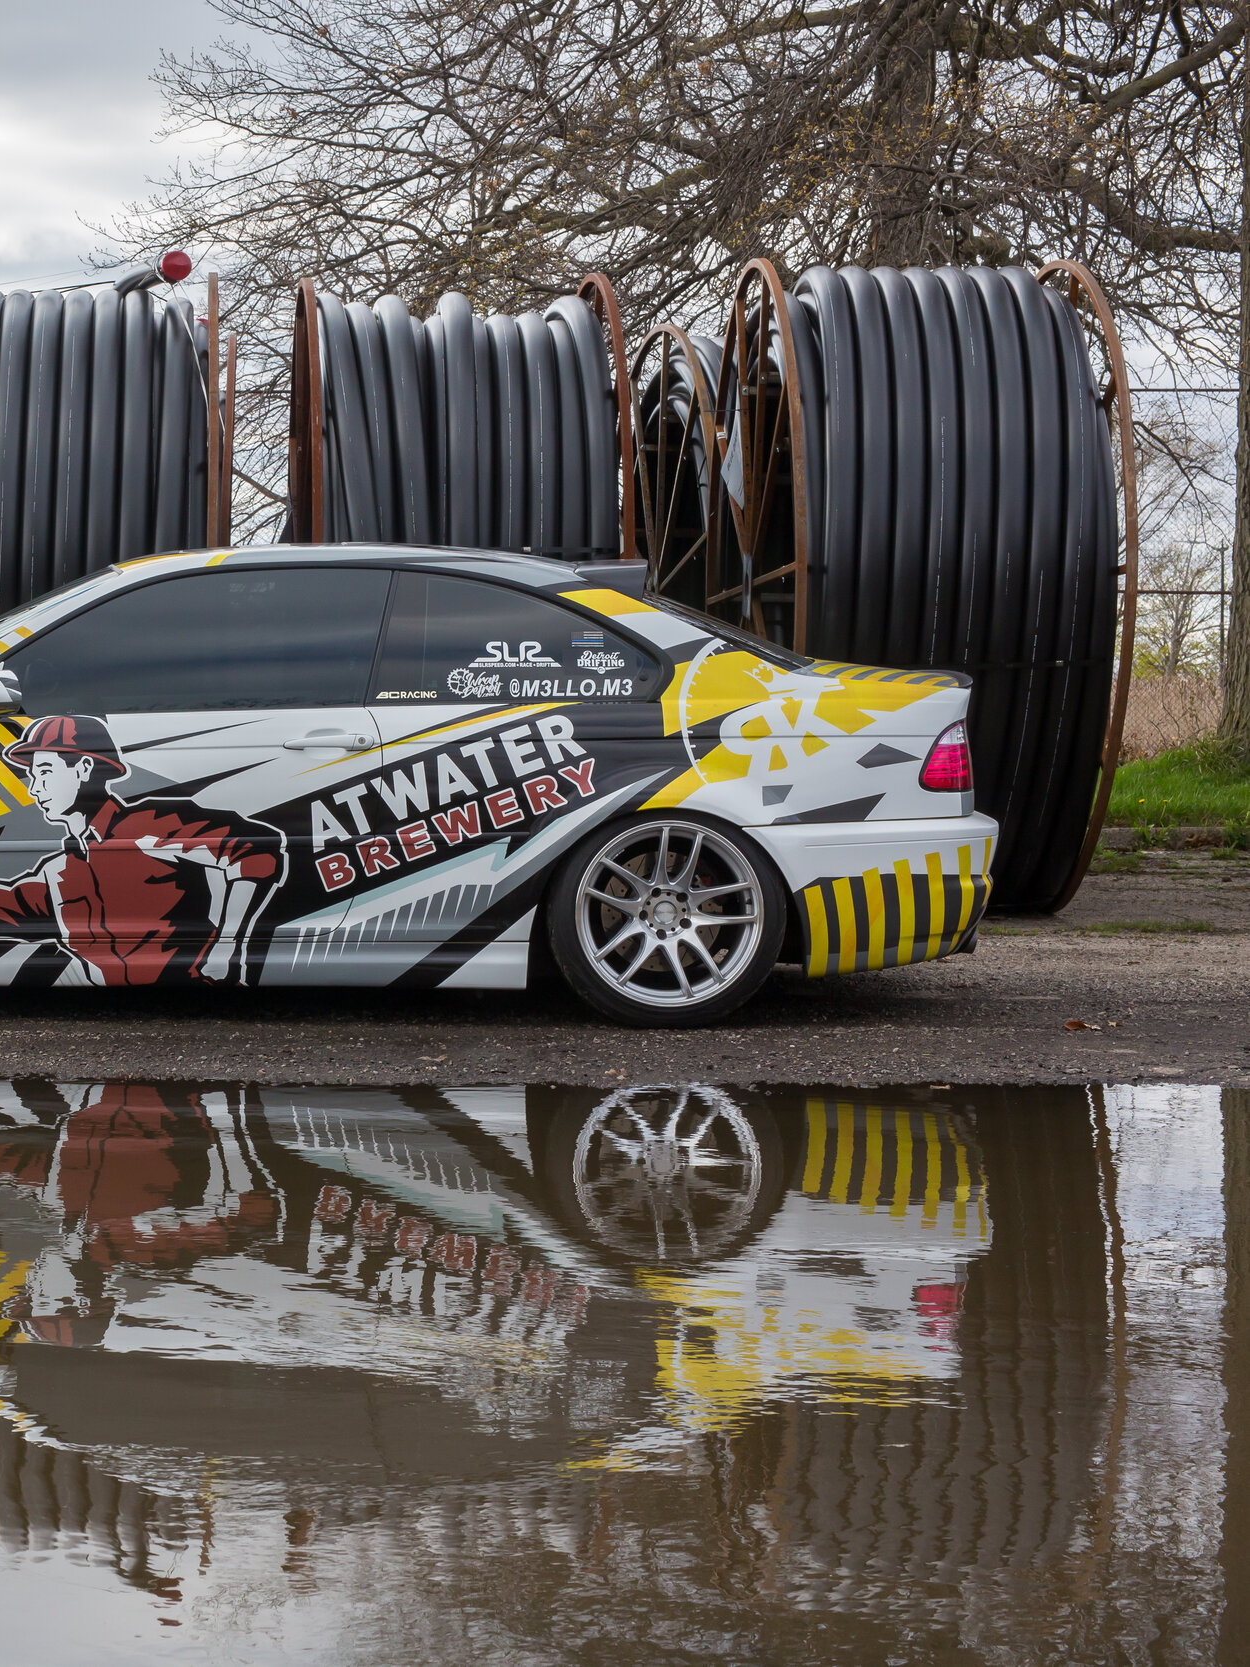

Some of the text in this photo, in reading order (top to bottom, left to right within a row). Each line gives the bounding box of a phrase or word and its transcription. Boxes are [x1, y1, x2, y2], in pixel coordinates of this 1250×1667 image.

[474, 641, 555, 662] SLR
[580, 650, 621, 660] Detroit
[577, 659, 625, 667] DRIFTING
[465, 671, 500, 688] Wrap
[510, 678, 633, 697] @M3LLO.M3
[400, 690, 438, 699] RACING
[461, 682, 504, 698] Detroit
[311, 714, 587, 853] ATWATER
[314, 757, 596, 893] BREWERY
